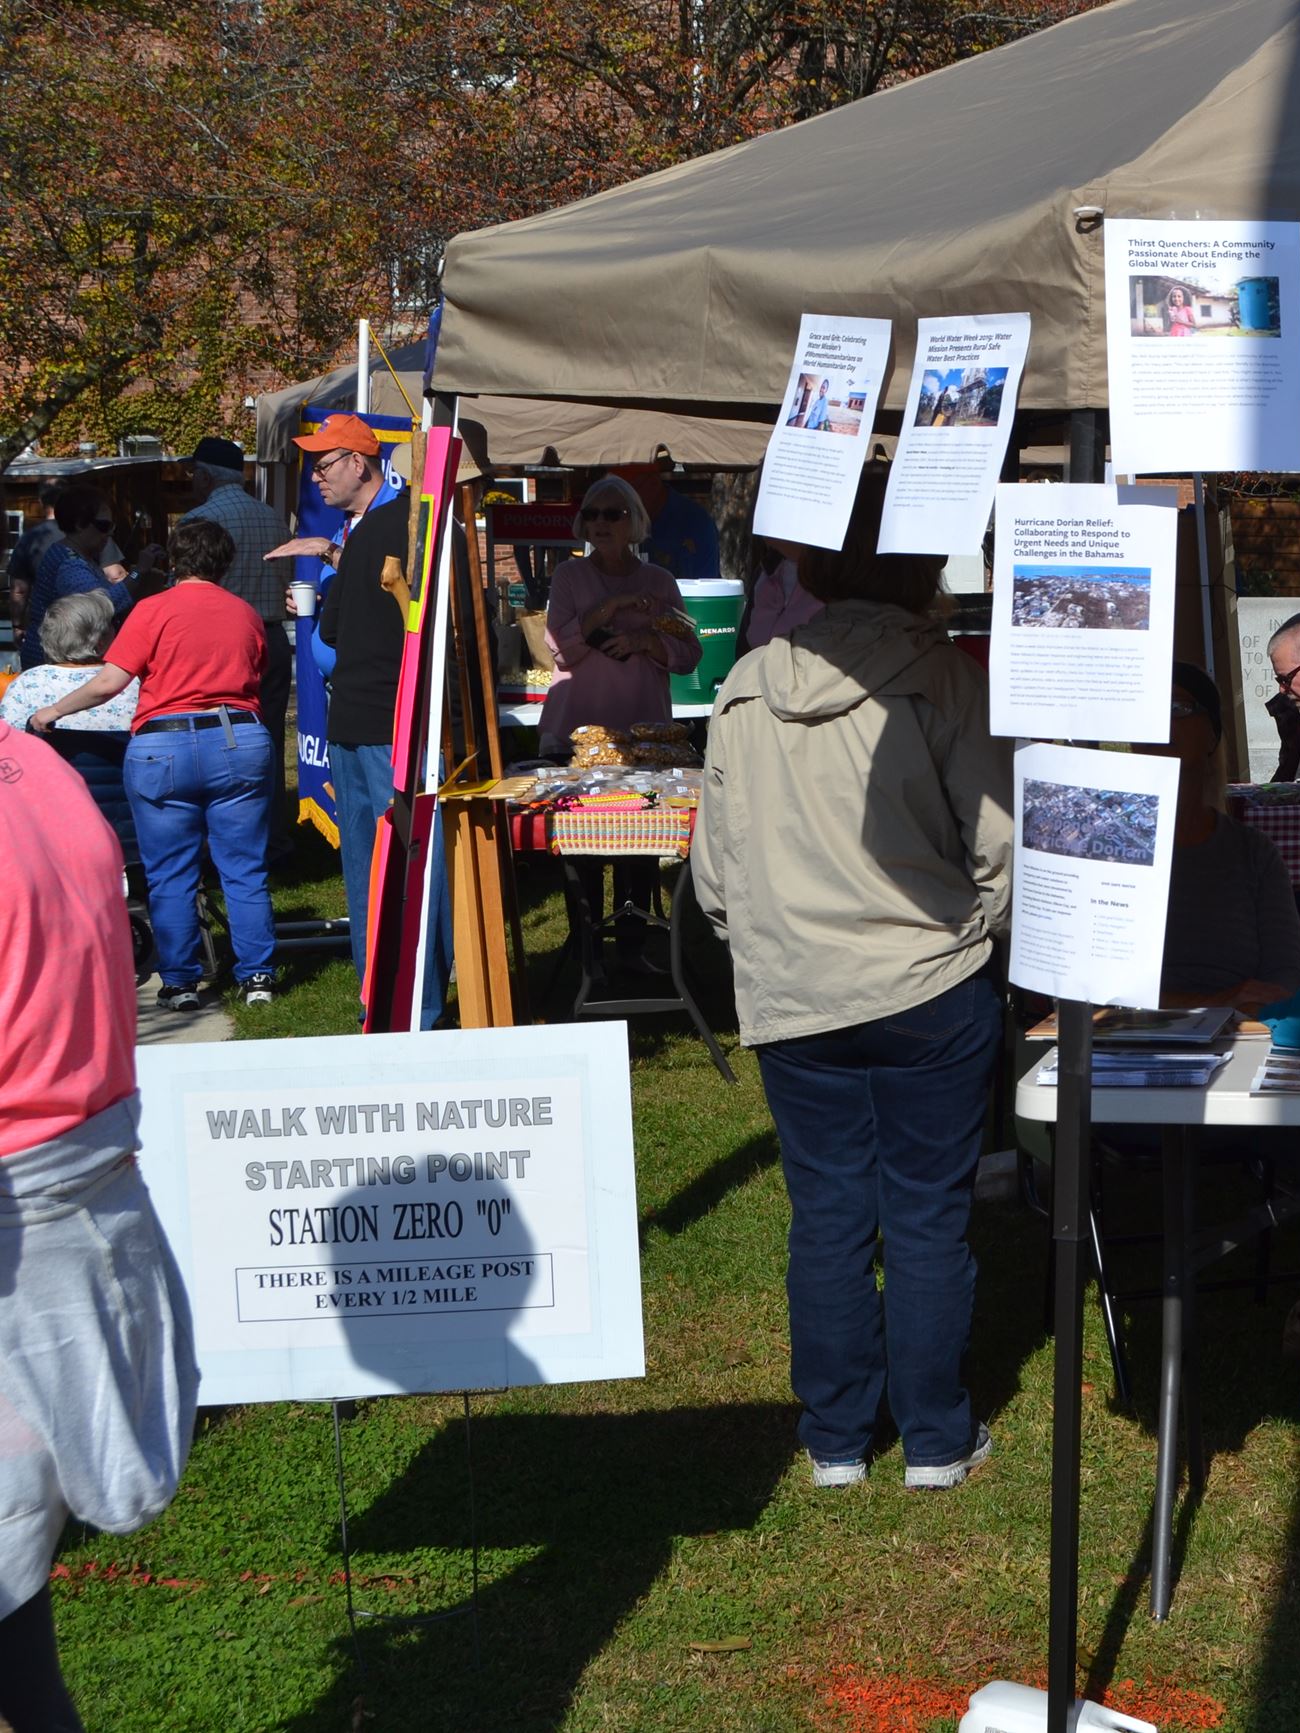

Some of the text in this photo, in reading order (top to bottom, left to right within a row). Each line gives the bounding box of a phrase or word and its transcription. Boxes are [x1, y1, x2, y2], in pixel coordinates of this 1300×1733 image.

[1128, 239, 1276, 251] Thirst Quenchers: A Community
[1128, 250, 1260, 261] Passionate About Ending the
[1128, 260, 1217, 269] Global Water Crisis
[809, 332, 821, 341] Grace
[841, 336, 867, 346] Celebrating
[946, 334, 962, 342] Water
[963, 334, 978, 342] Week
[994, 333, 1012, 341] Water
[808, 342, 842, 352] Water Mission's
[973, 343, 988, 351] Rural
[989, 343, 1001, 351] Safe
[944, 354, 954, 362] Best
[956, 354, 980, 362] Practices
[803, 360, 856, 372] World Humanitarian Day
[1014, 518, 1114, 528] Hurricane Dorian Relief:
[1014, 528, 1068, 538] Collaborating
[1070, 530, 1080, 538] to
[1082, 530, 1118, 540] Respond
[1014, 539, 1120, 550] Urgent Needs and Unique
[1014, 549, 1124, 559] Challenges in the Bahamas
[1242, 636, 1260, 648] OF
[1246, 652, 1264, 664] TO
[1255, 685, 1273, 698] OF
[1092, 840, 1148, 859] Dorian
[1110, 900, 1128, 908] News
[206, 1097, 554, 1140] WALK WITH NATURE
[245, 1150, 531, 1191] STARTING POINT
[269, 1198, 512, 1247] STATION ZERO "0"
[254, 1260, 536, 1290] THERE IS A MILEAGE POST
[314, 1286, 478, 1310] EVERY 1/2 MILE
